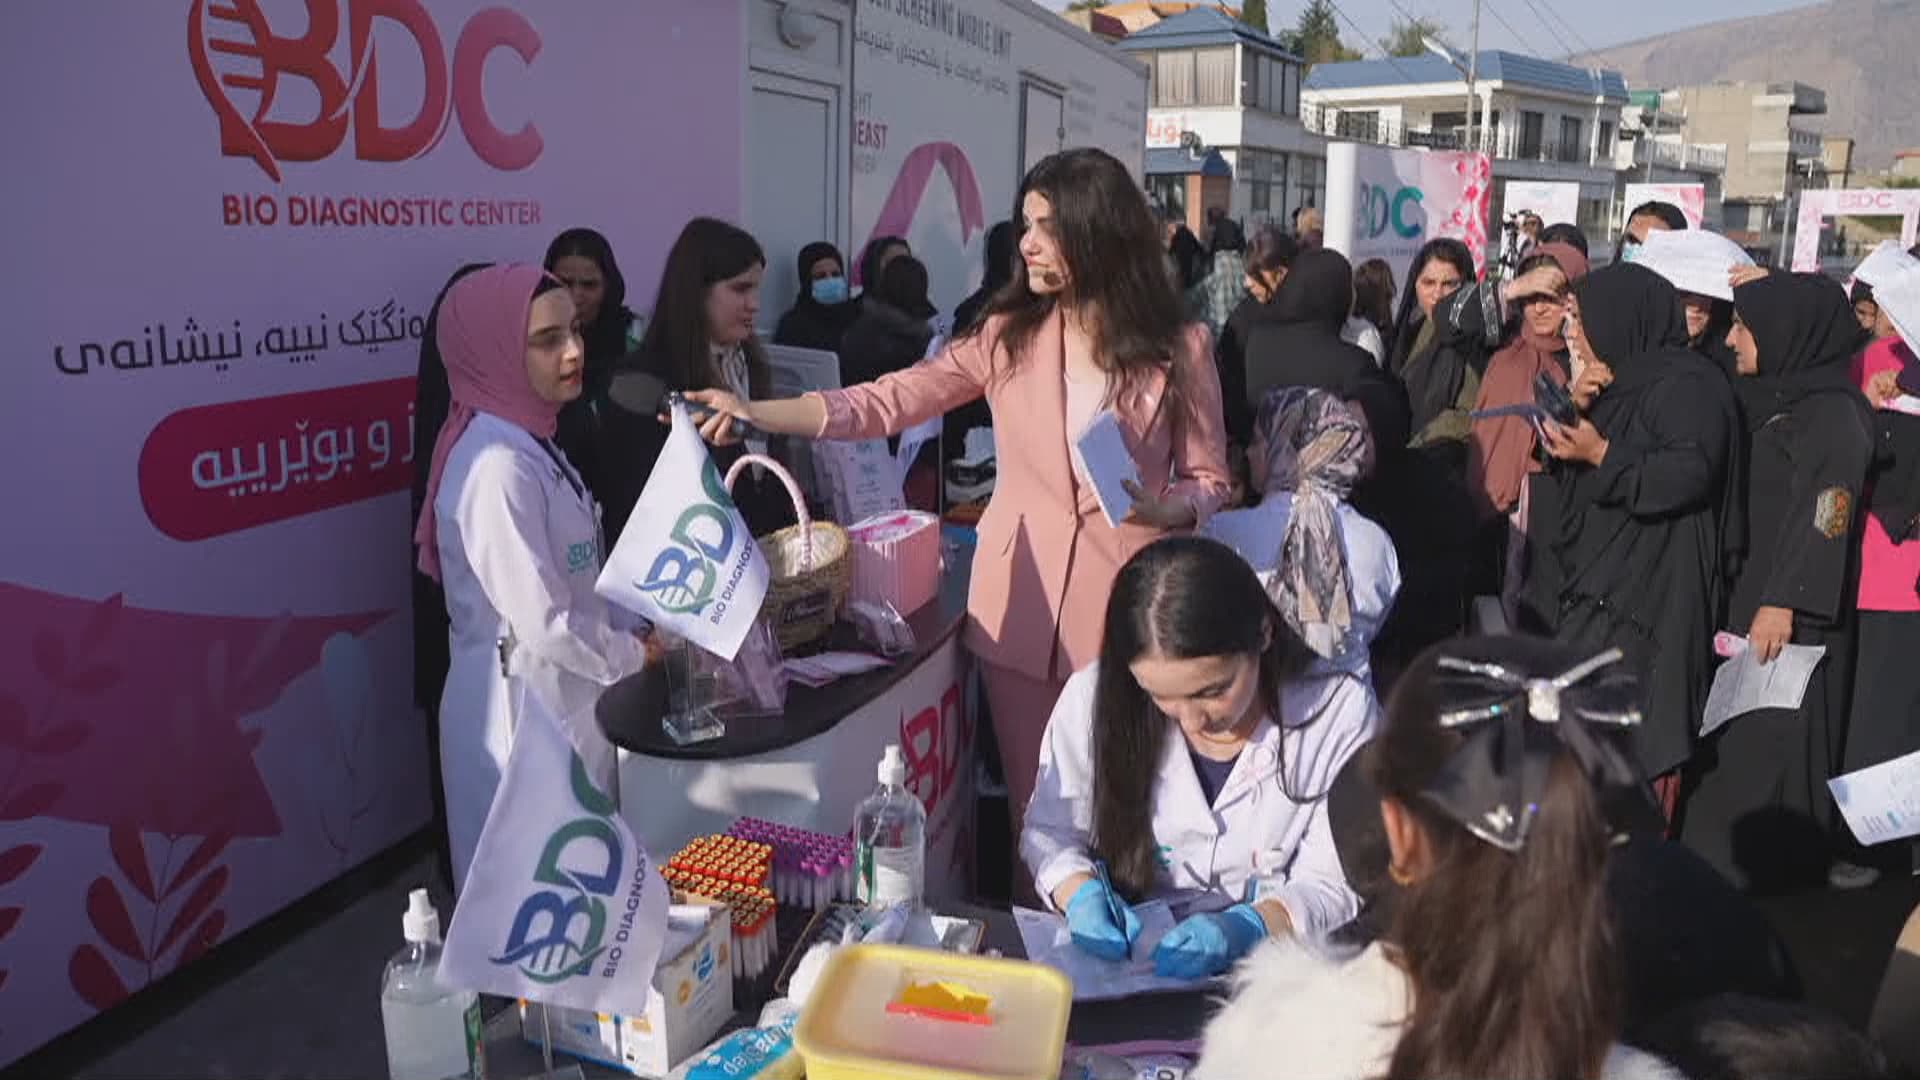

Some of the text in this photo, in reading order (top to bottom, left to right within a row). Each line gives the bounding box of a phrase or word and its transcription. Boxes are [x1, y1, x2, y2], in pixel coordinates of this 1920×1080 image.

[188, 0, 545, 182] BDC
[222, 195, 541, 227] BIO DIAGNOSTIC CENTER
[709, 602, 726, 625] BIO
[602, 946, 622, 979] BIO
